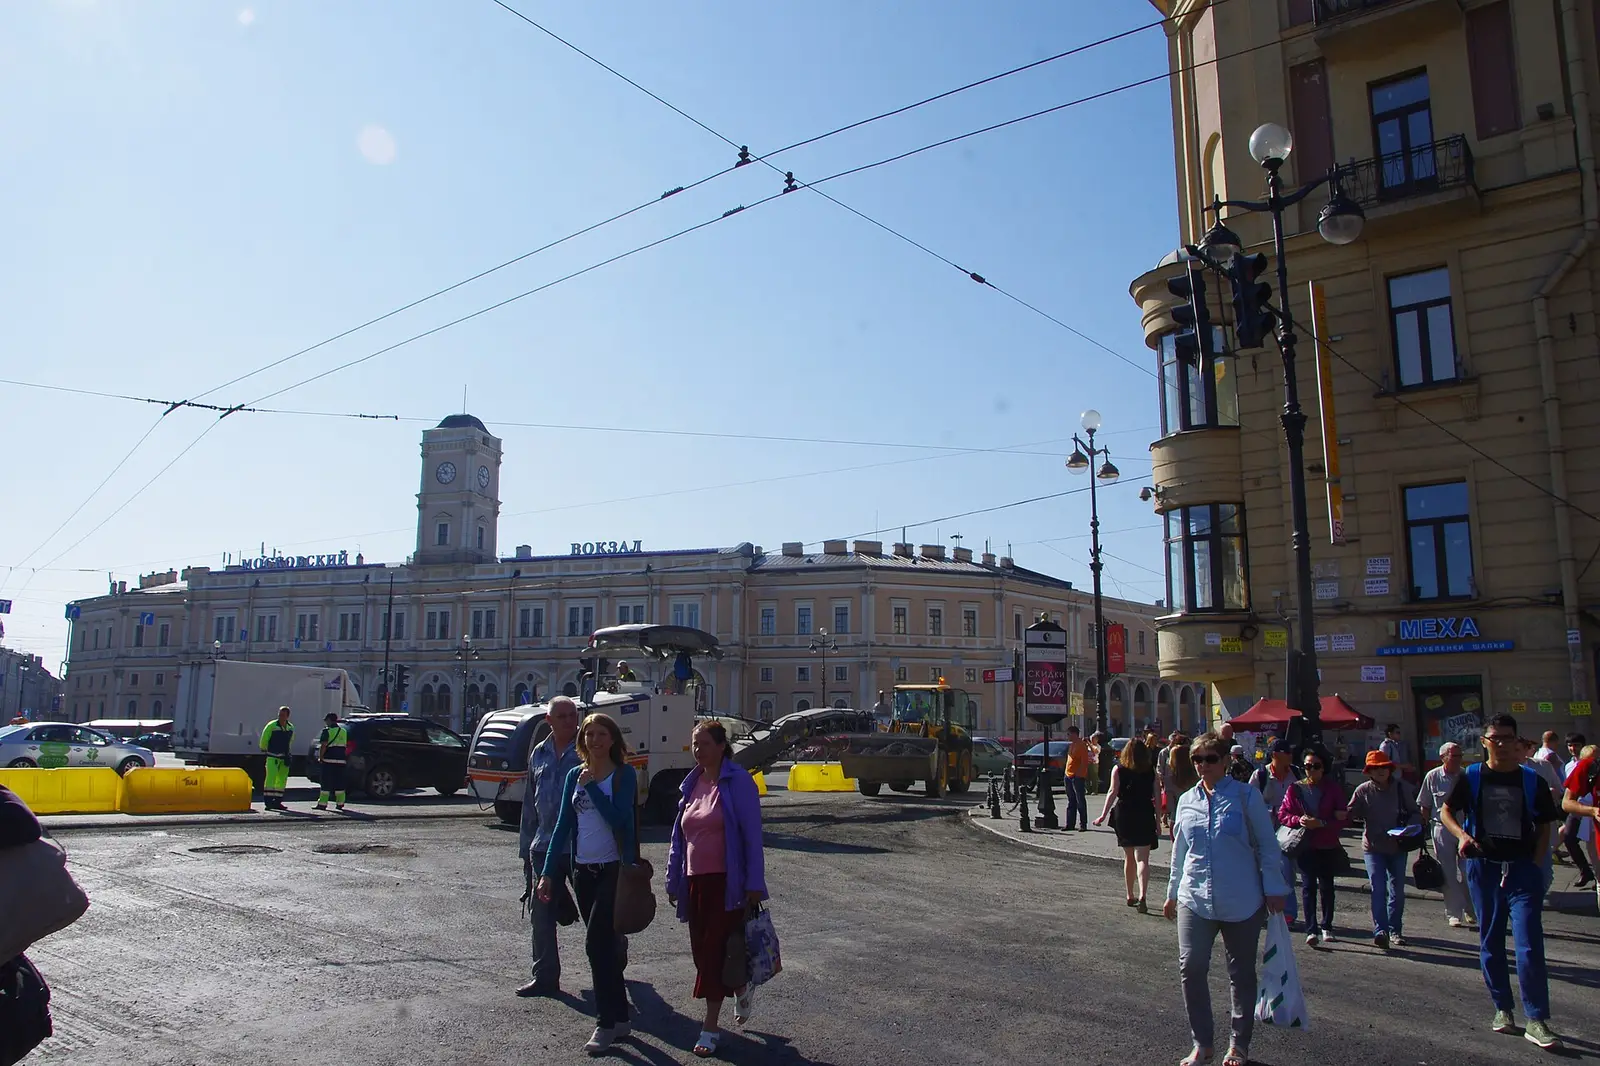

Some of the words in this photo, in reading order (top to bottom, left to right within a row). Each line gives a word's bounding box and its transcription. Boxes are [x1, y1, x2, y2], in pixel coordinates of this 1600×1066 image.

[242, 550, 349, 570] МОСКОВСКИЙ
[570, 540, 642, 555] ВОКЗАЛ
[1400, 616, 1480, 639] МЕХА
[1417, 645, 1464, 653] ДУБЛЕНКИ
[1472, 643, 1505, 651] ШАПКИ
[1027, 670, 1065, 679] СКИДКИ
[1032, 681, 1064, 698] 50%
